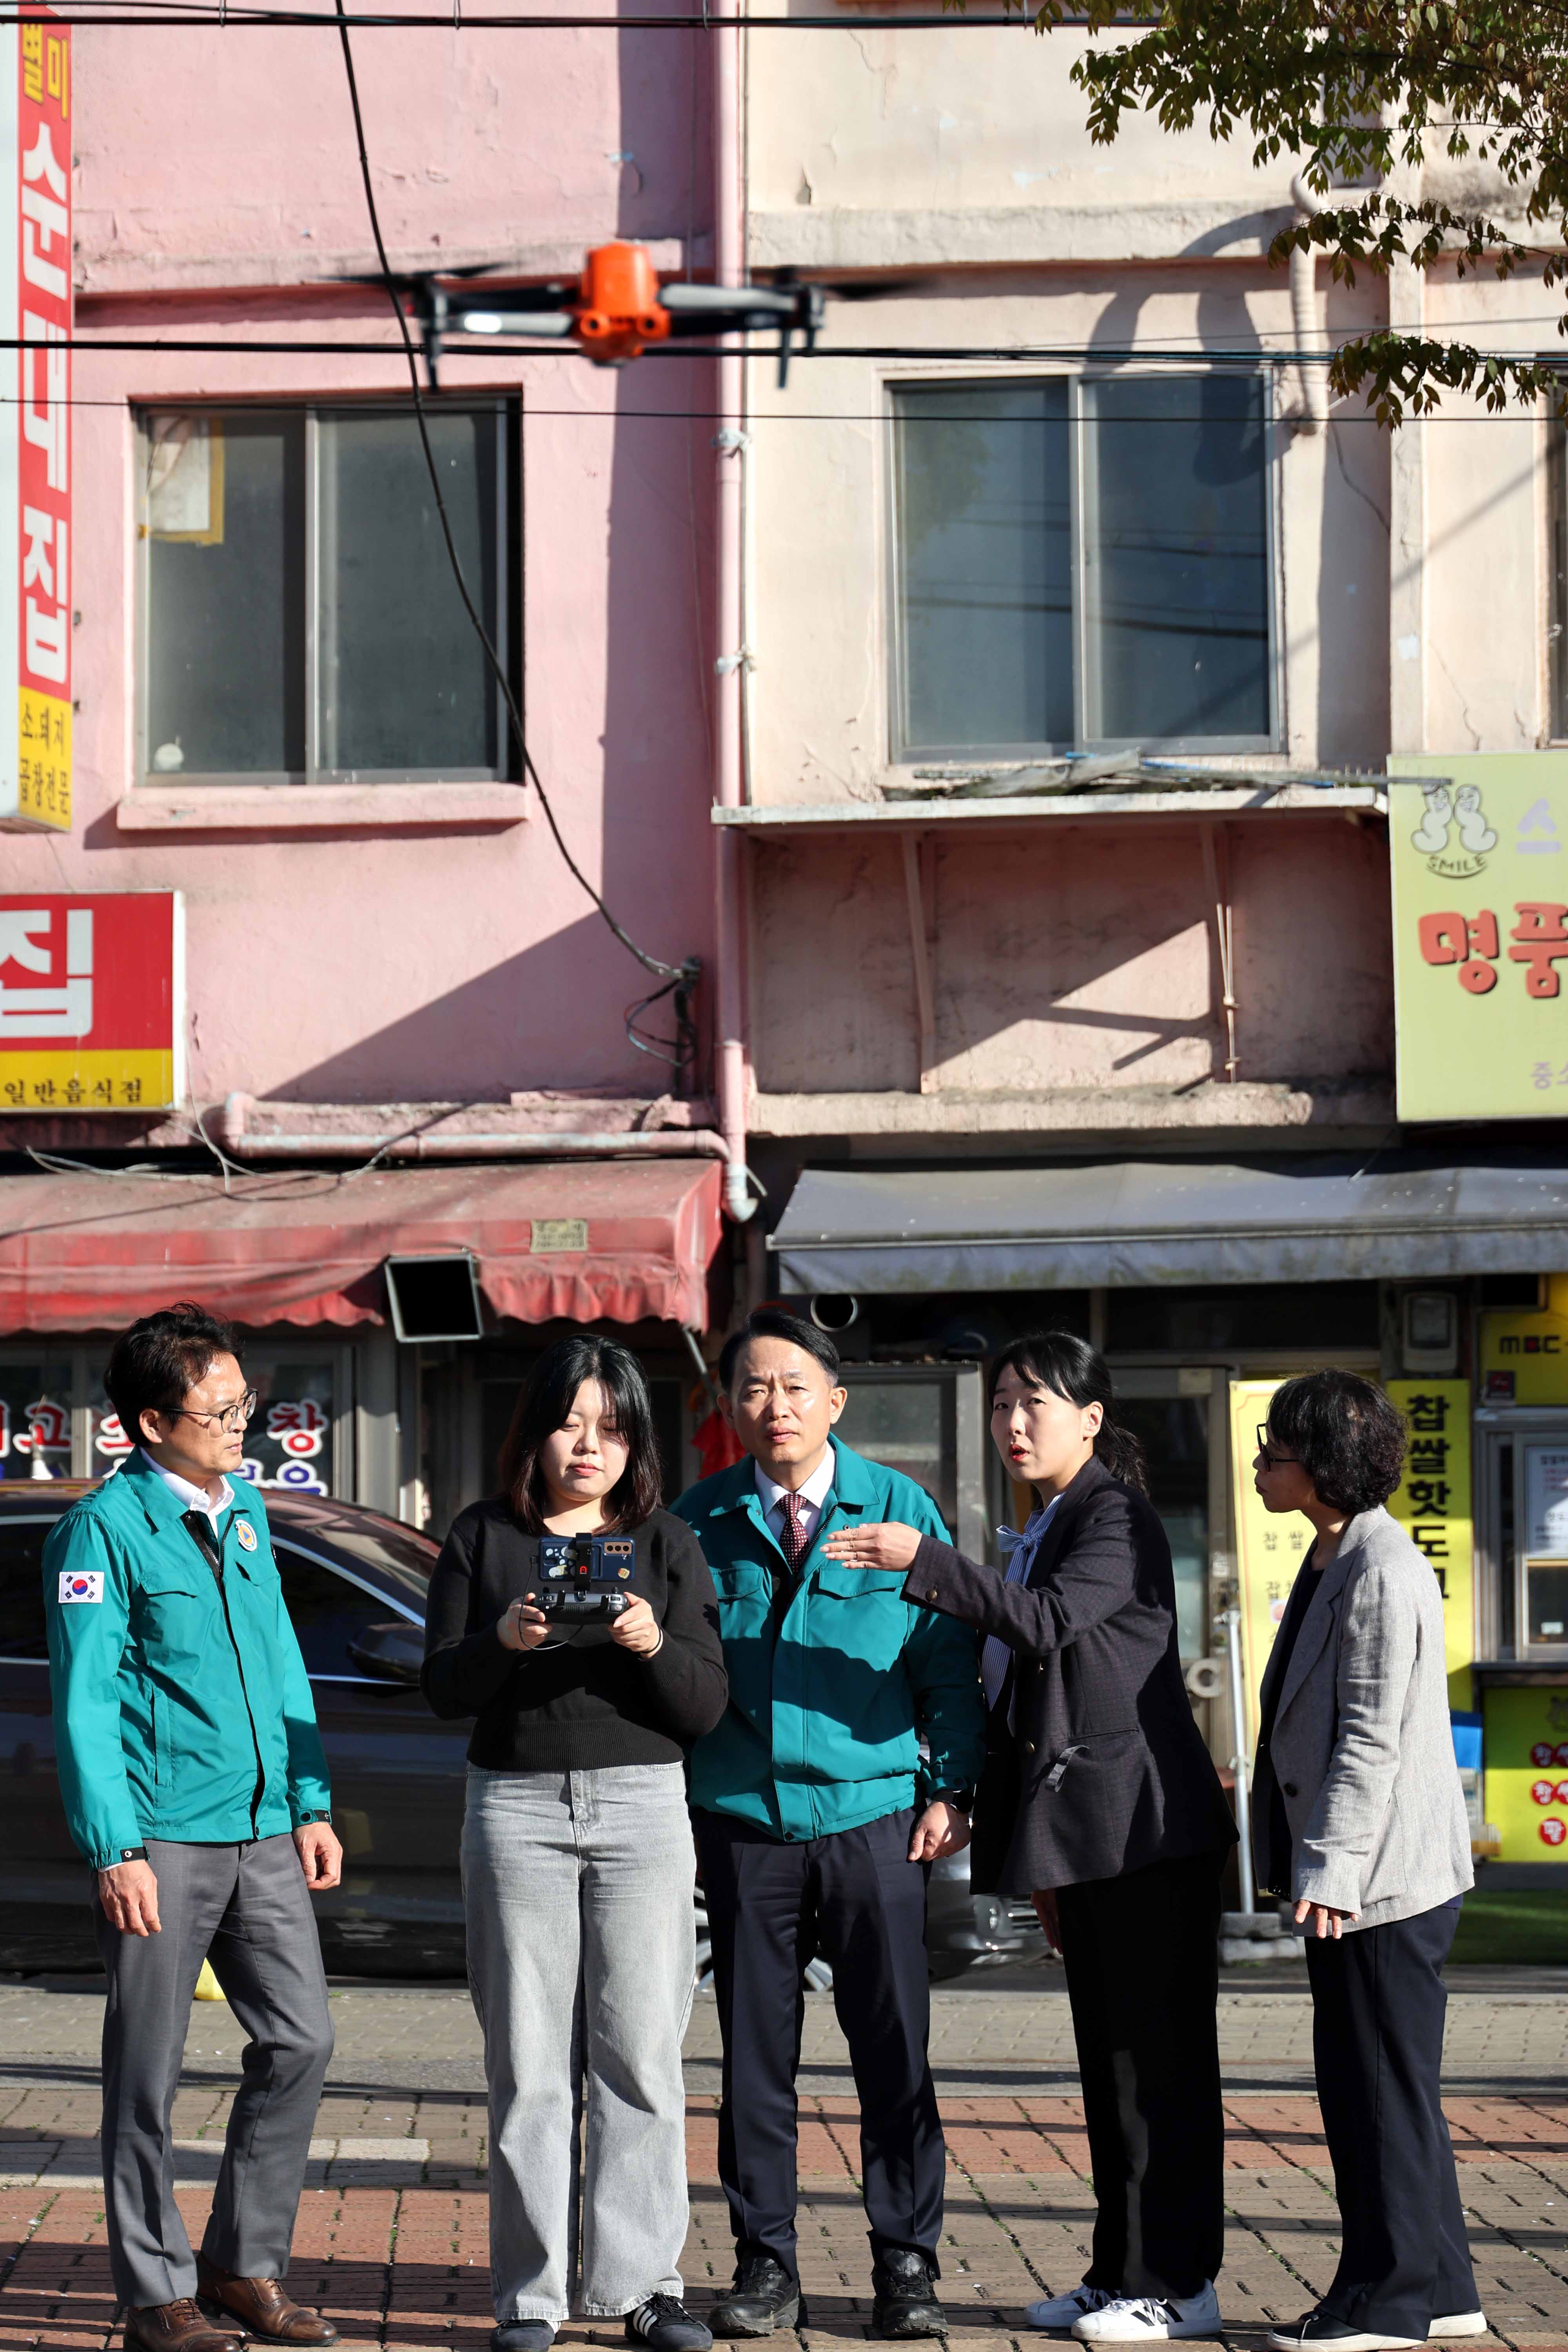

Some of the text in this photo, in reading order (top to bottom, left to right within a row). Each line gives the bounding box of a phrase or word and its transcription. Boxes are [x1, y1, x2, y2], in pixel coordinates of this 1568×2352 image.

[22, 22, 68, 120] 별미
[22, 121, 67, 685] 순대집
[19, 758, 69, 814] 곱창전문
[1428, 853, 1486, 873] SMILE
[4, 1077, 142, 1105] 일반음식점
